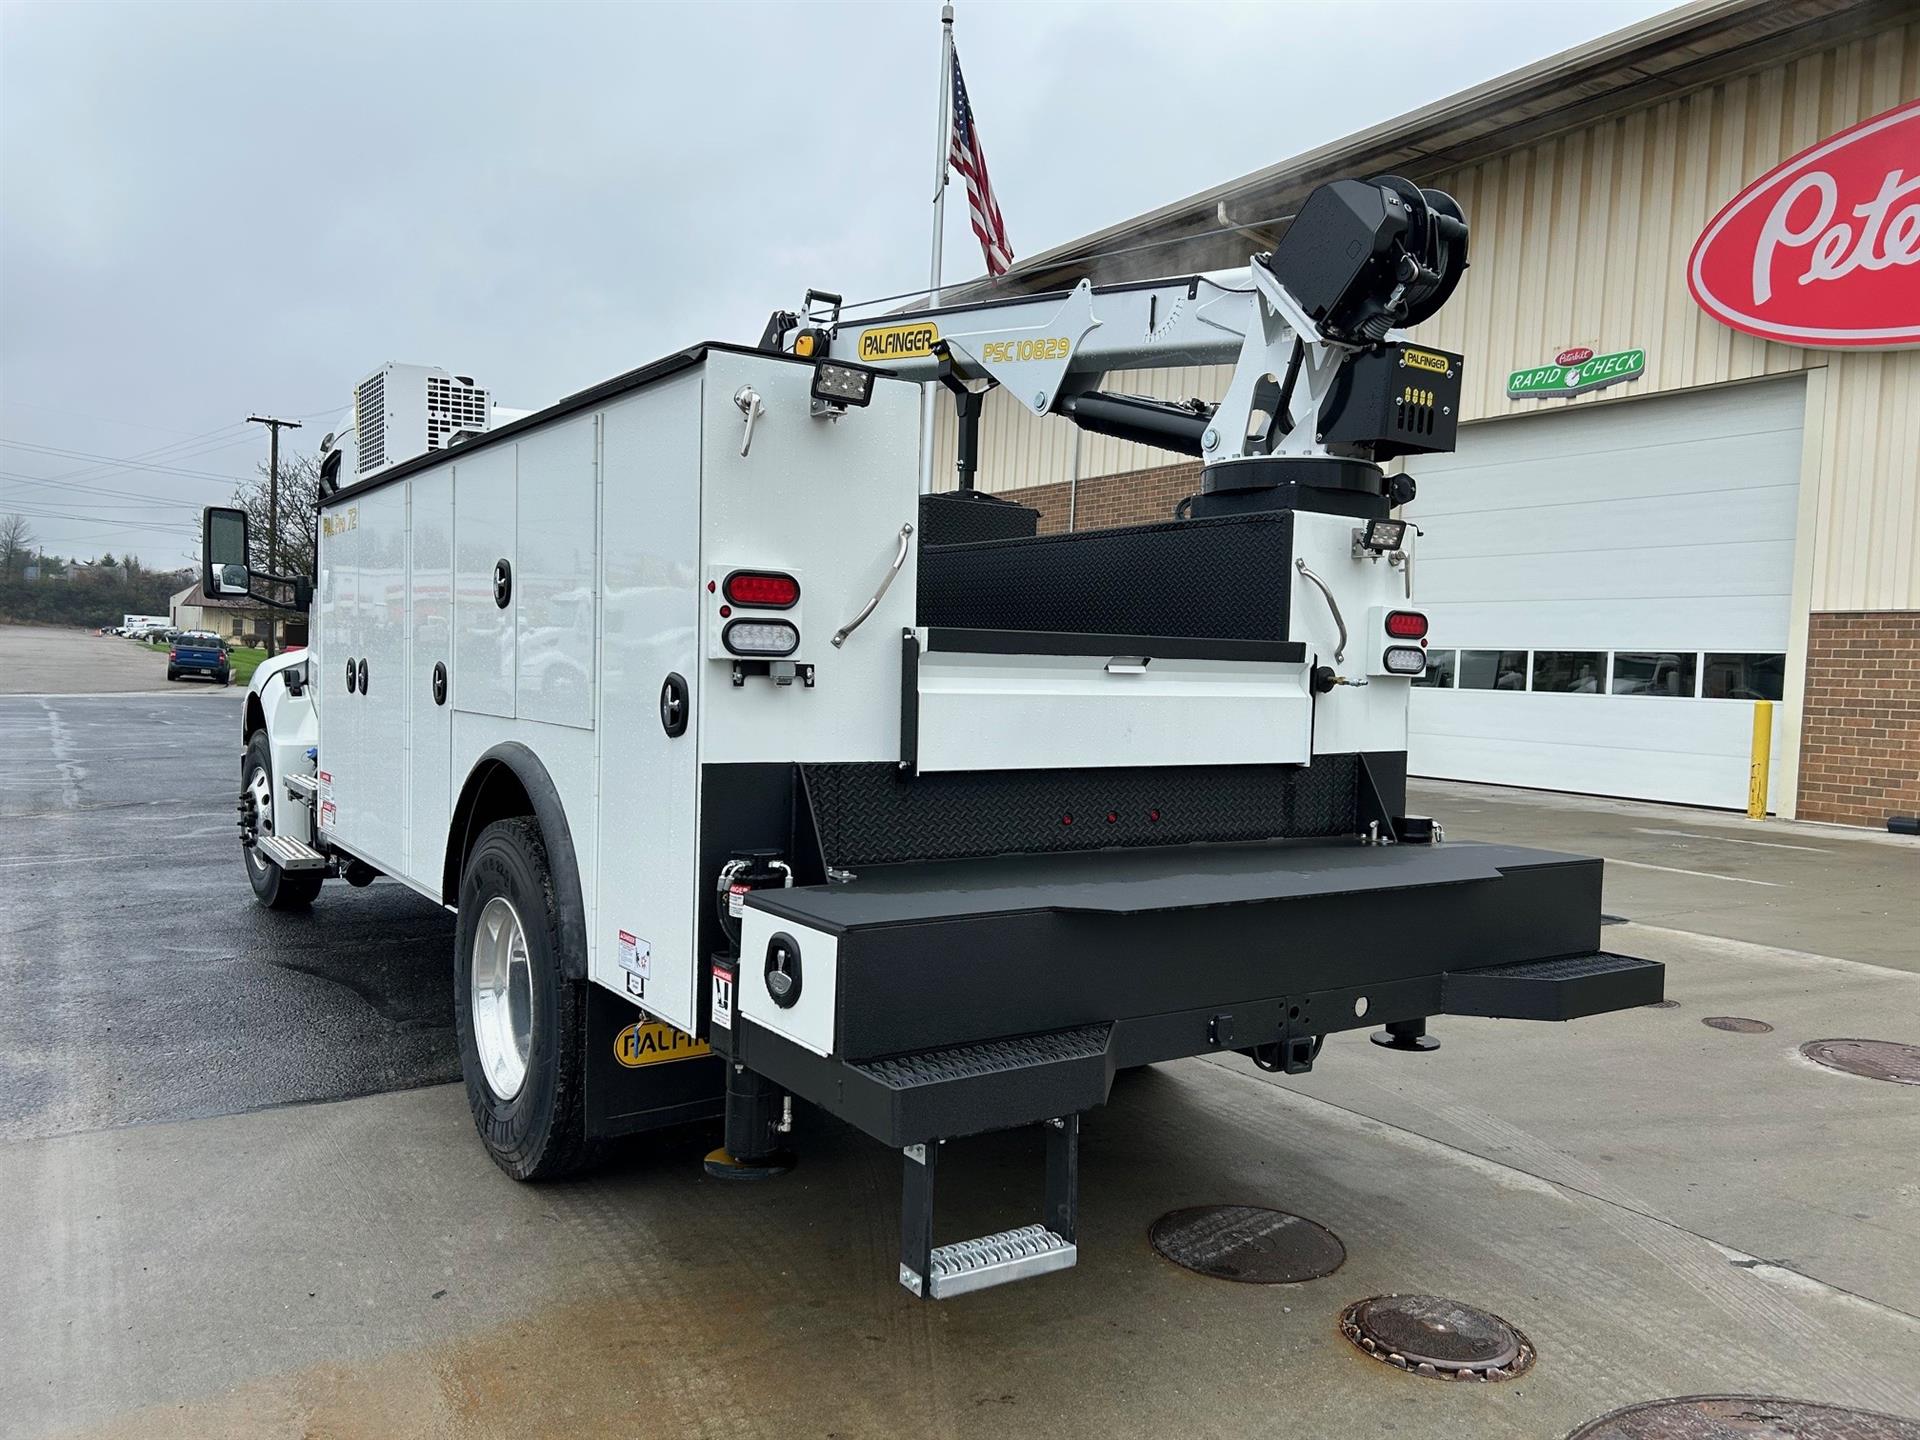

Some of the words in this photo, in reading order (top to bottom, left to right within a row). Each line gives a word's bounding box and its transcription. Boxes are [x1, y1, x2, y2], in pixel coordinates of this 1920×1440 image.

[862, 329, 933, 356] PALFINGER
[1407, 352, 1446, 370] PALFINGER
[1559, 350, 1591, 364] Peterbilt
[1511, 368, 1561, 390] RAPID
[1582, 353, 1640, 377] CHECK
